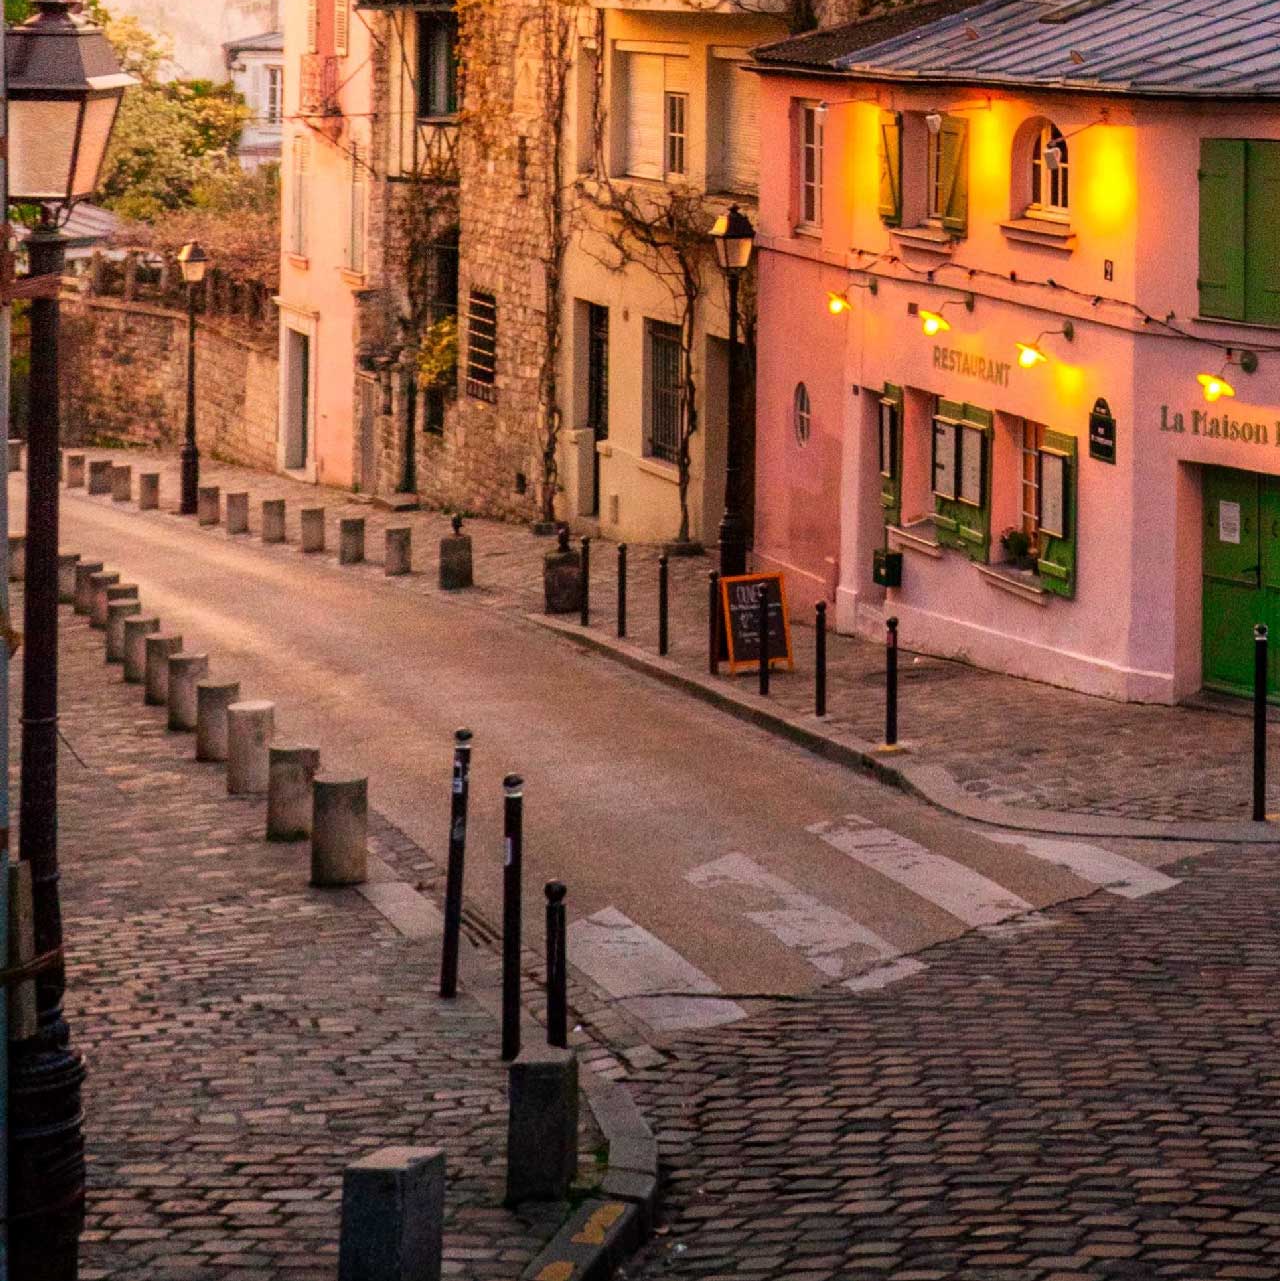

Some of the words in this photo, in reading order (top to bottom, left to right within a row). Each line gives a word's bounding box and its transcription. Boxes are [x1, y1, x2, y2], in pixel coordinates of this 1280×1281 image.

[933, 345, 1012, 388] RESTAURANT
[1160, 405, 1185, 433] La
[1191, 408, 1268, 445] Maison
